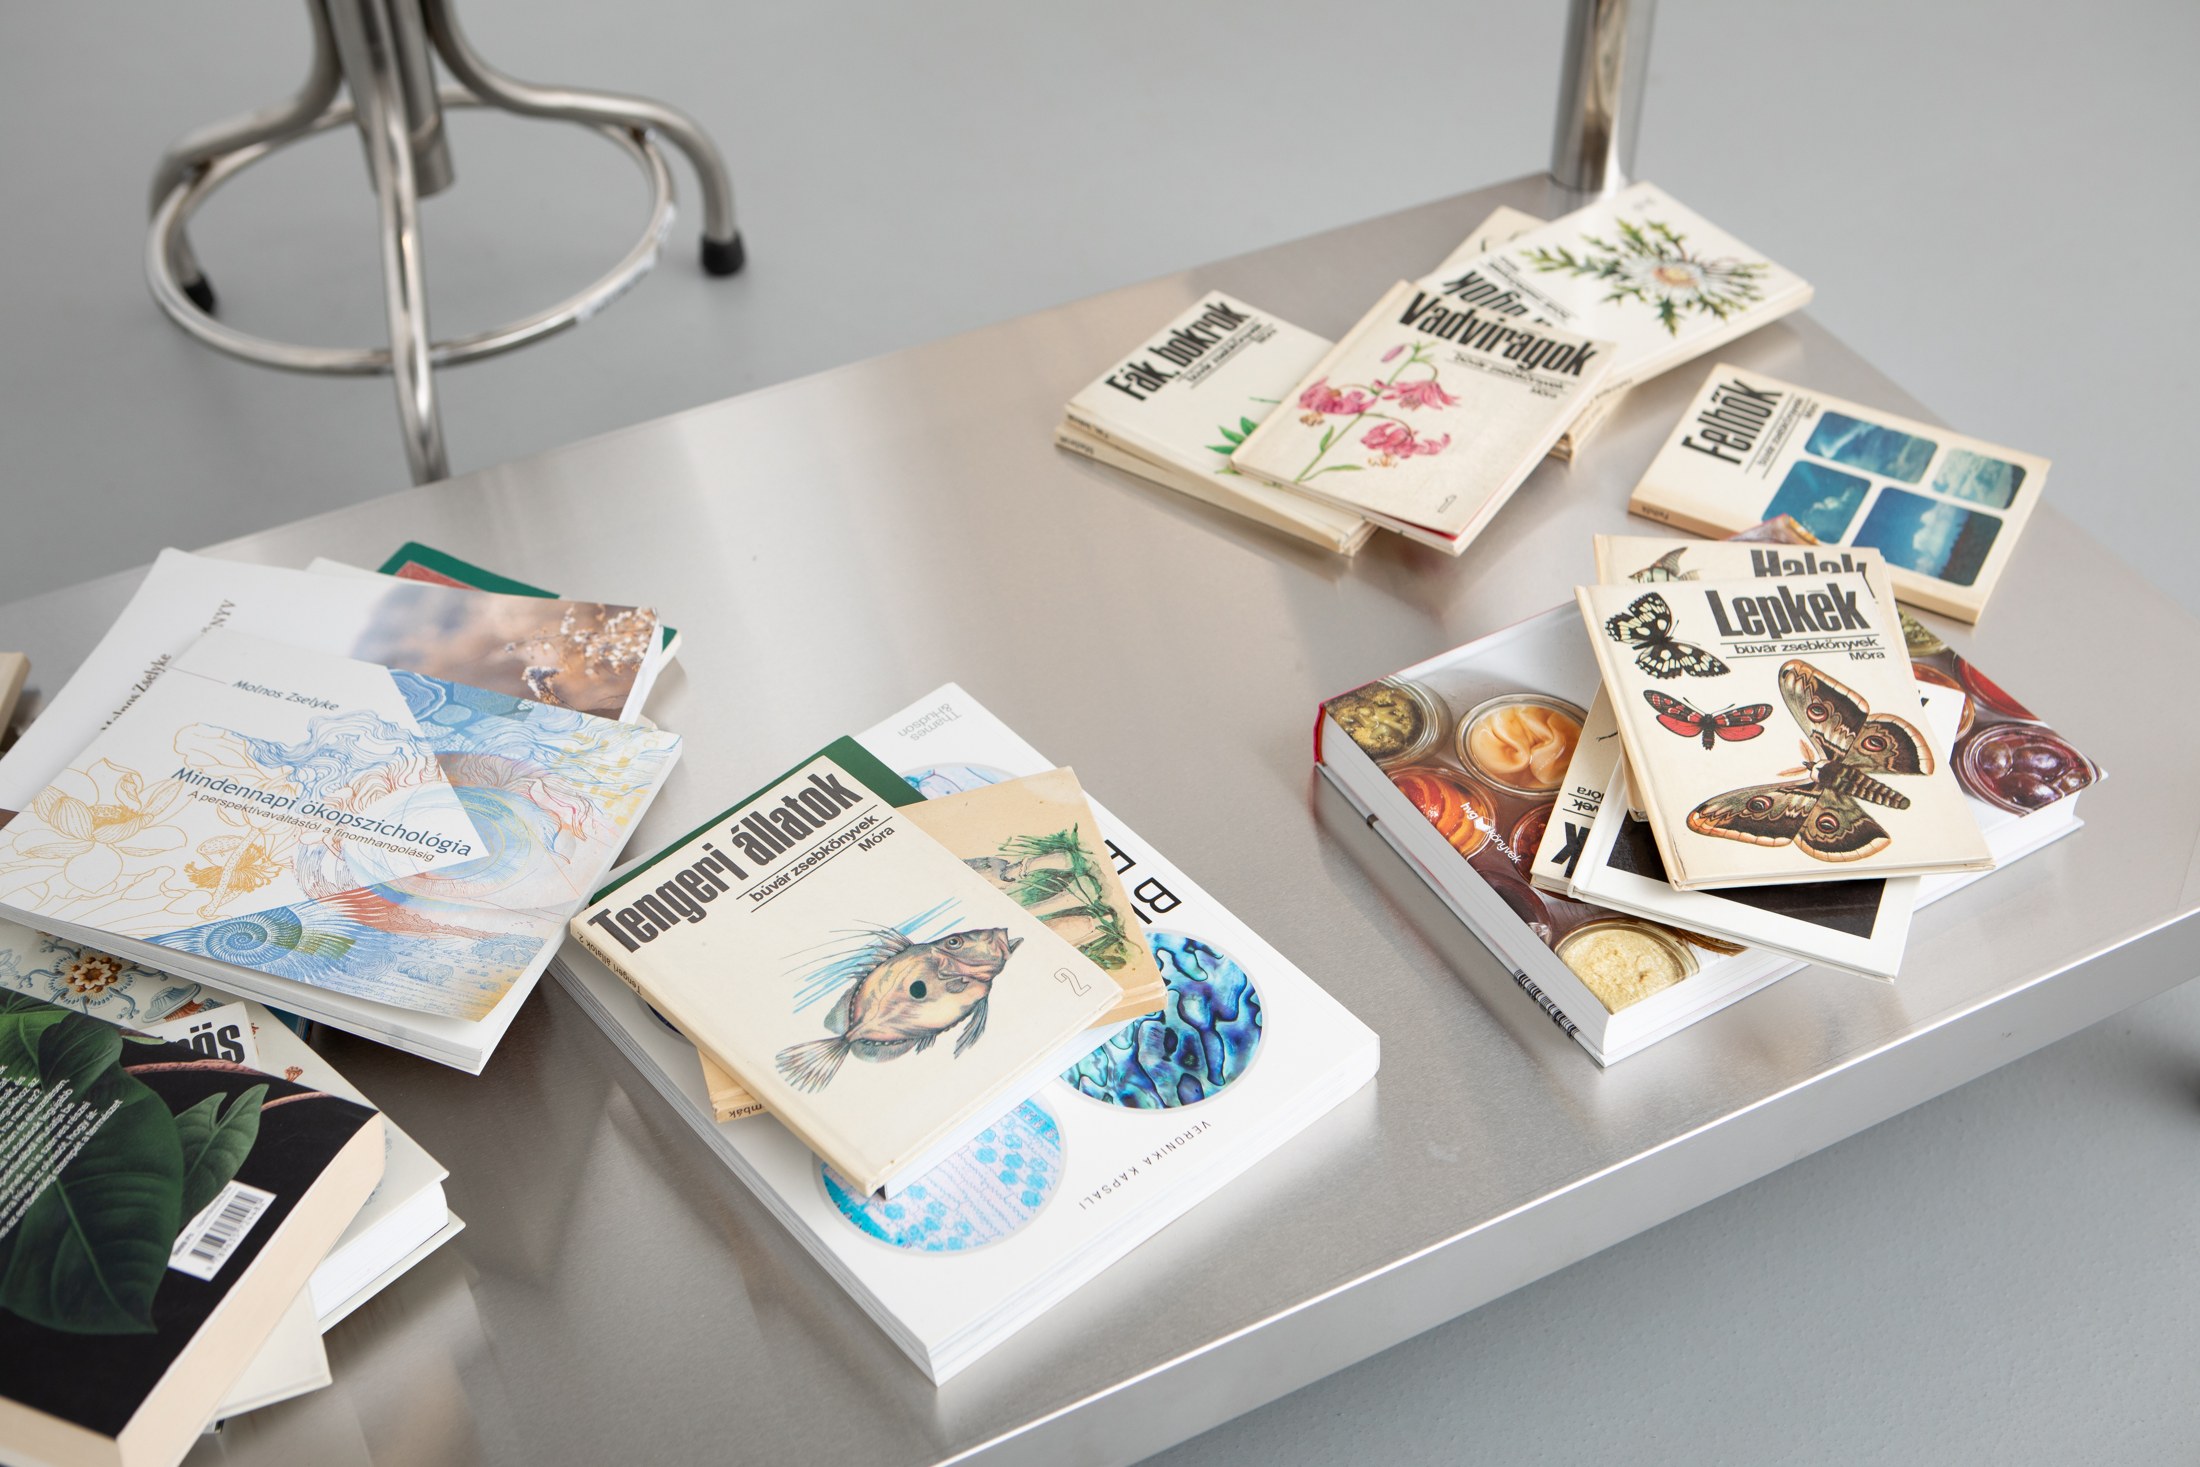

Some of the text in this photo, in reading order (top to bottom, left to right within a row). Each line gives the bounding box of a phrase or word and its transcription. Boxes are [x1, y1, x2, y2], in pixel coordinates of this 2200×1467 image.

[1104, 302, 1251, 402] Fák, bokrok
[1398, 290, 1599, 377] Vadvirágok
[1681, 377, 1783, 465] Felhők
[1705, 583, 1871, 639] Lepkék
[1734, 636, 1879, 655] búvár zsebkönyvek
[1849, 651, 1886, 661] Móra
[233, 680, 340, 712] Molnos Zselyke
[910, 714, 962, 741] Thames
[171, 767, 472, 858] Mindennapi ökopszichológia
[187, 790, 436, 863] A perspektívaváltástól a finomhangolásig
[1460, 801, 1479, 820] hvg
[587, 773, 864, 953] Tengeri állatok
[749, 814, 880, 902] búvár zsebkönyvek
[857, 826, 896, 852] Móra
[1487, 827, 1523, 864] könyvek
[1053, 967, 1092, 997] 2
[1079, 1120, 1212, 1211] VERONIKA KAPSALI
